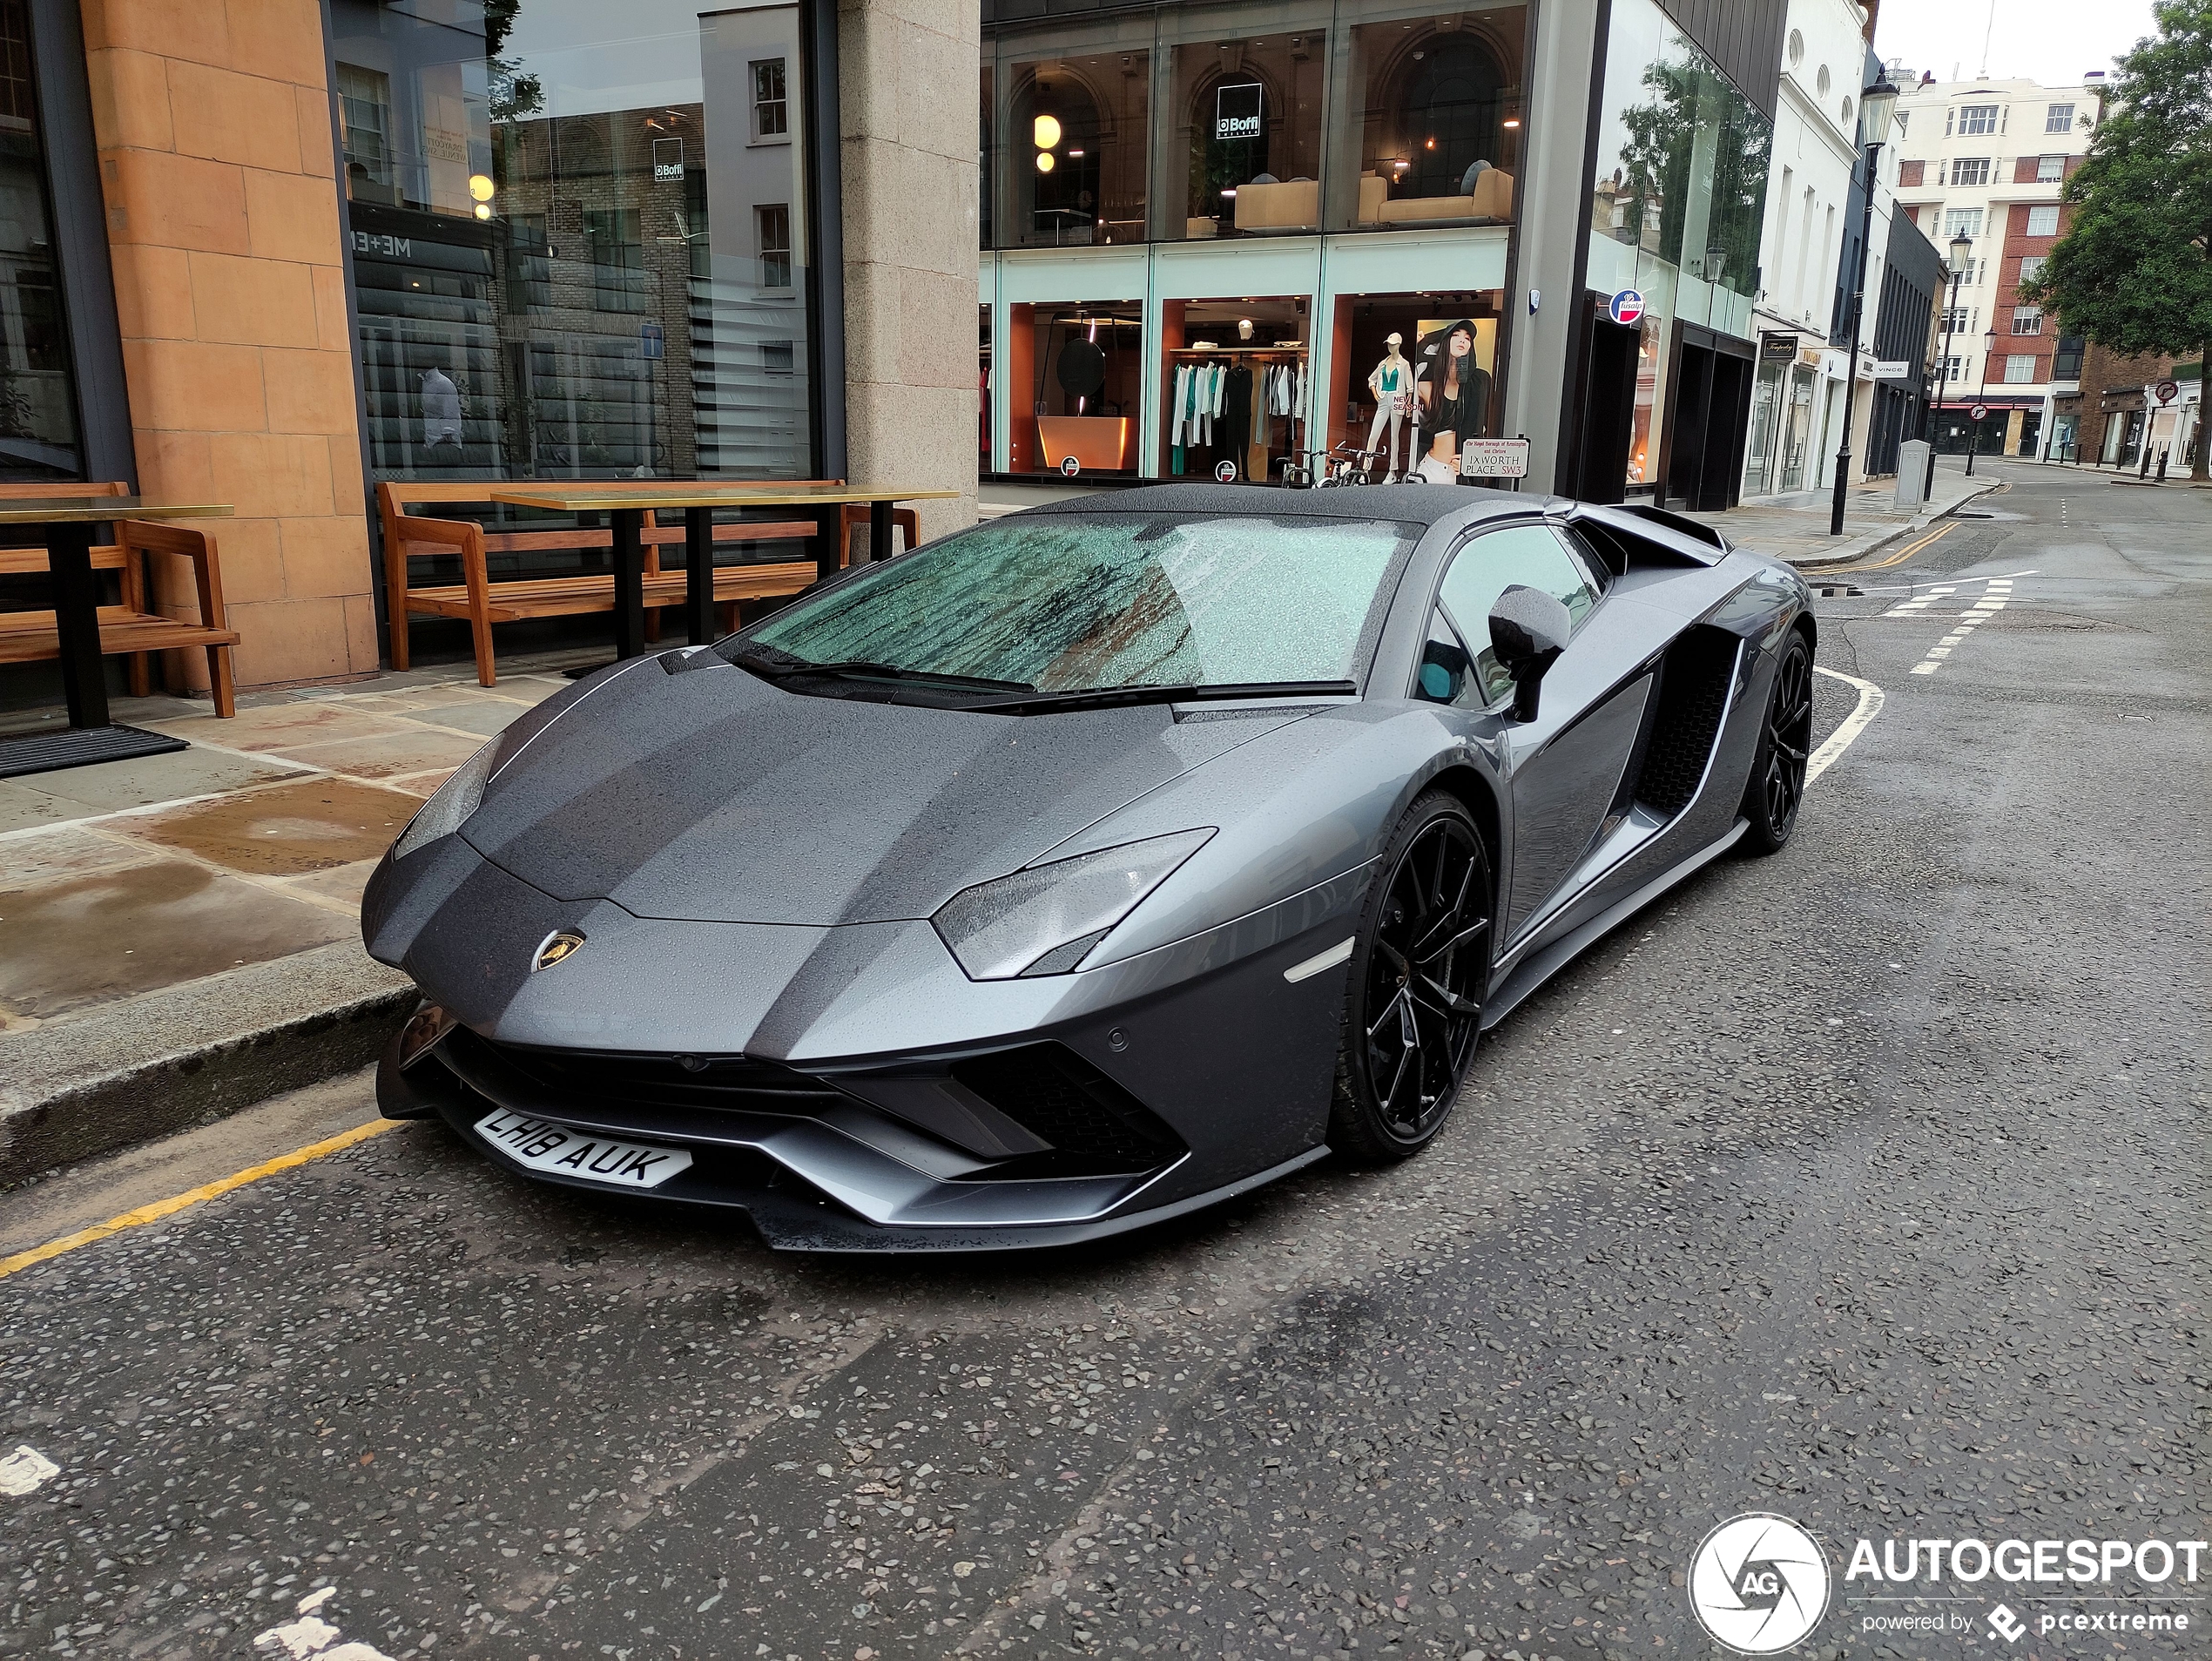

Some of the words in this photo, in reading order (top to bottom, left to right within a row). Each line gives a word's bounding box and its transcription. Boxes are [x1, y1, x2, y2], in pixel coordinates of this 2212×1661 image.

[1230, 116, 1258, 131] Boffi
[663, 164, 682, 176] Boffi
[1469, 456, 1520, 465] IXWORTH
[484, 1113, 569, 1158] LH18
[554, 1142, 671, 1180] AUK
